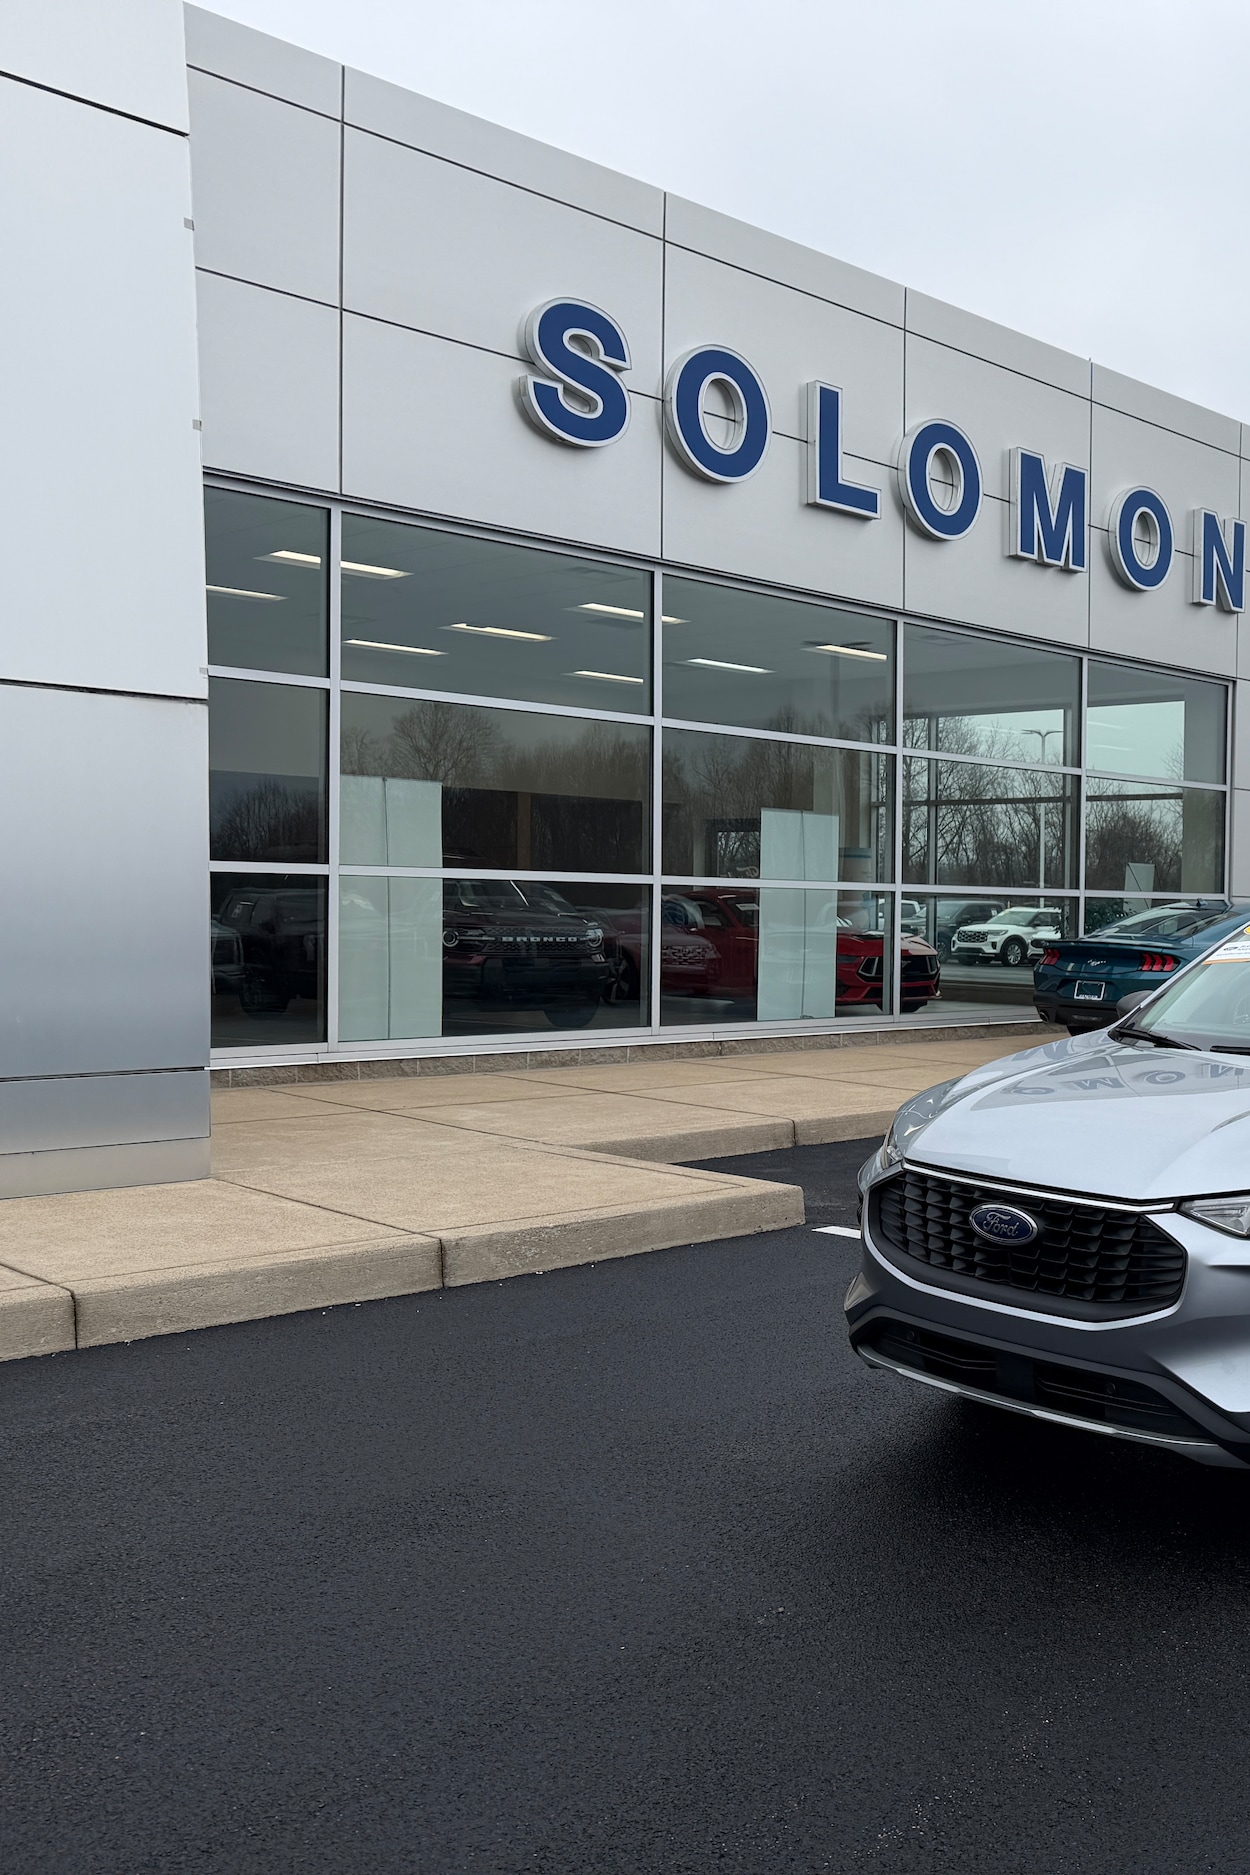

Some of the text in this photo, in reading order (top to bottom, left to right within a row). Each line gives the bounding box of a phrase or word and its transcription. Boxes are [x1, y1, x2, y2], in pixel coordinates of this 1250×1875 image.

[519, 296, 1248, 613] SOLOMON
[501, 935, 578, 943] BRONCO
[982, 1211, 1020, 1238] Ford
